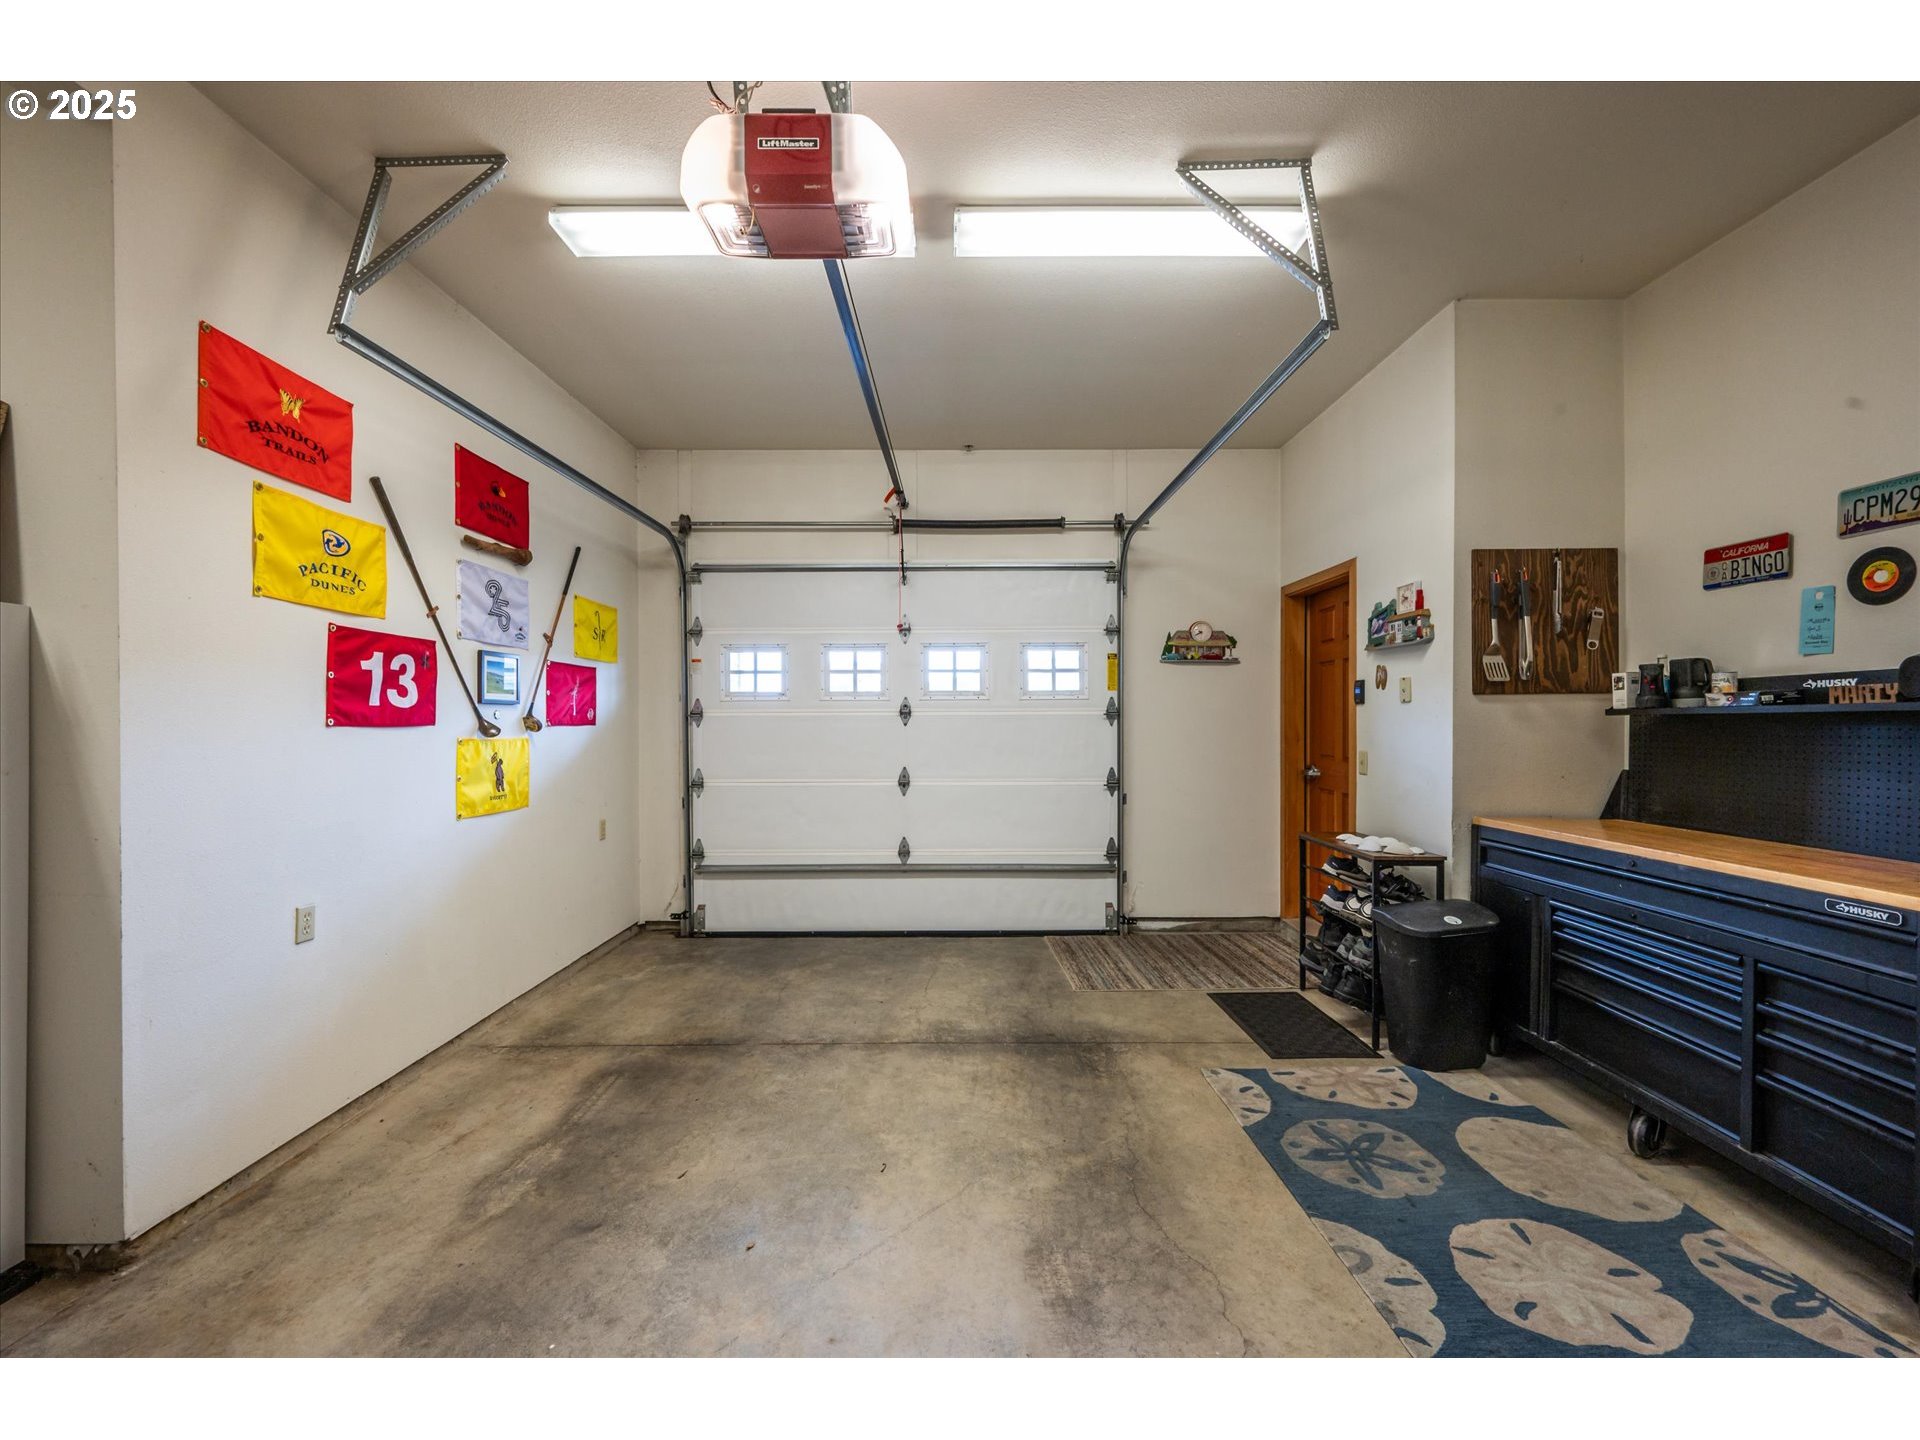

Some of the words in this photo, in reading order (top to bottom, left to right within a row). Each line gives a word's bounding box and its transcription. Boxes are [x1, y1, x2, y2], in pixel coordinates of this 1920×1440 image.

[761, 139, 815, 148] LiftMaster
[247, 420, 330, 465] BANDON
[261, 435, 317, 465] TRAILS
[1853, 485, 1920, 522] CPM29
[1722, 542, 1769, 558] CALIFORNIA
[298, 562, 367, 592] PACIFIC
[1731, 551, 1784, 579] BINGO
[311, 578, 356, 596] DUNES
[360, 651, 419, 709] 13
[1816, 678, 1857, 688] HUSKY
[1849, 905, 1889, 921] HUSKY
